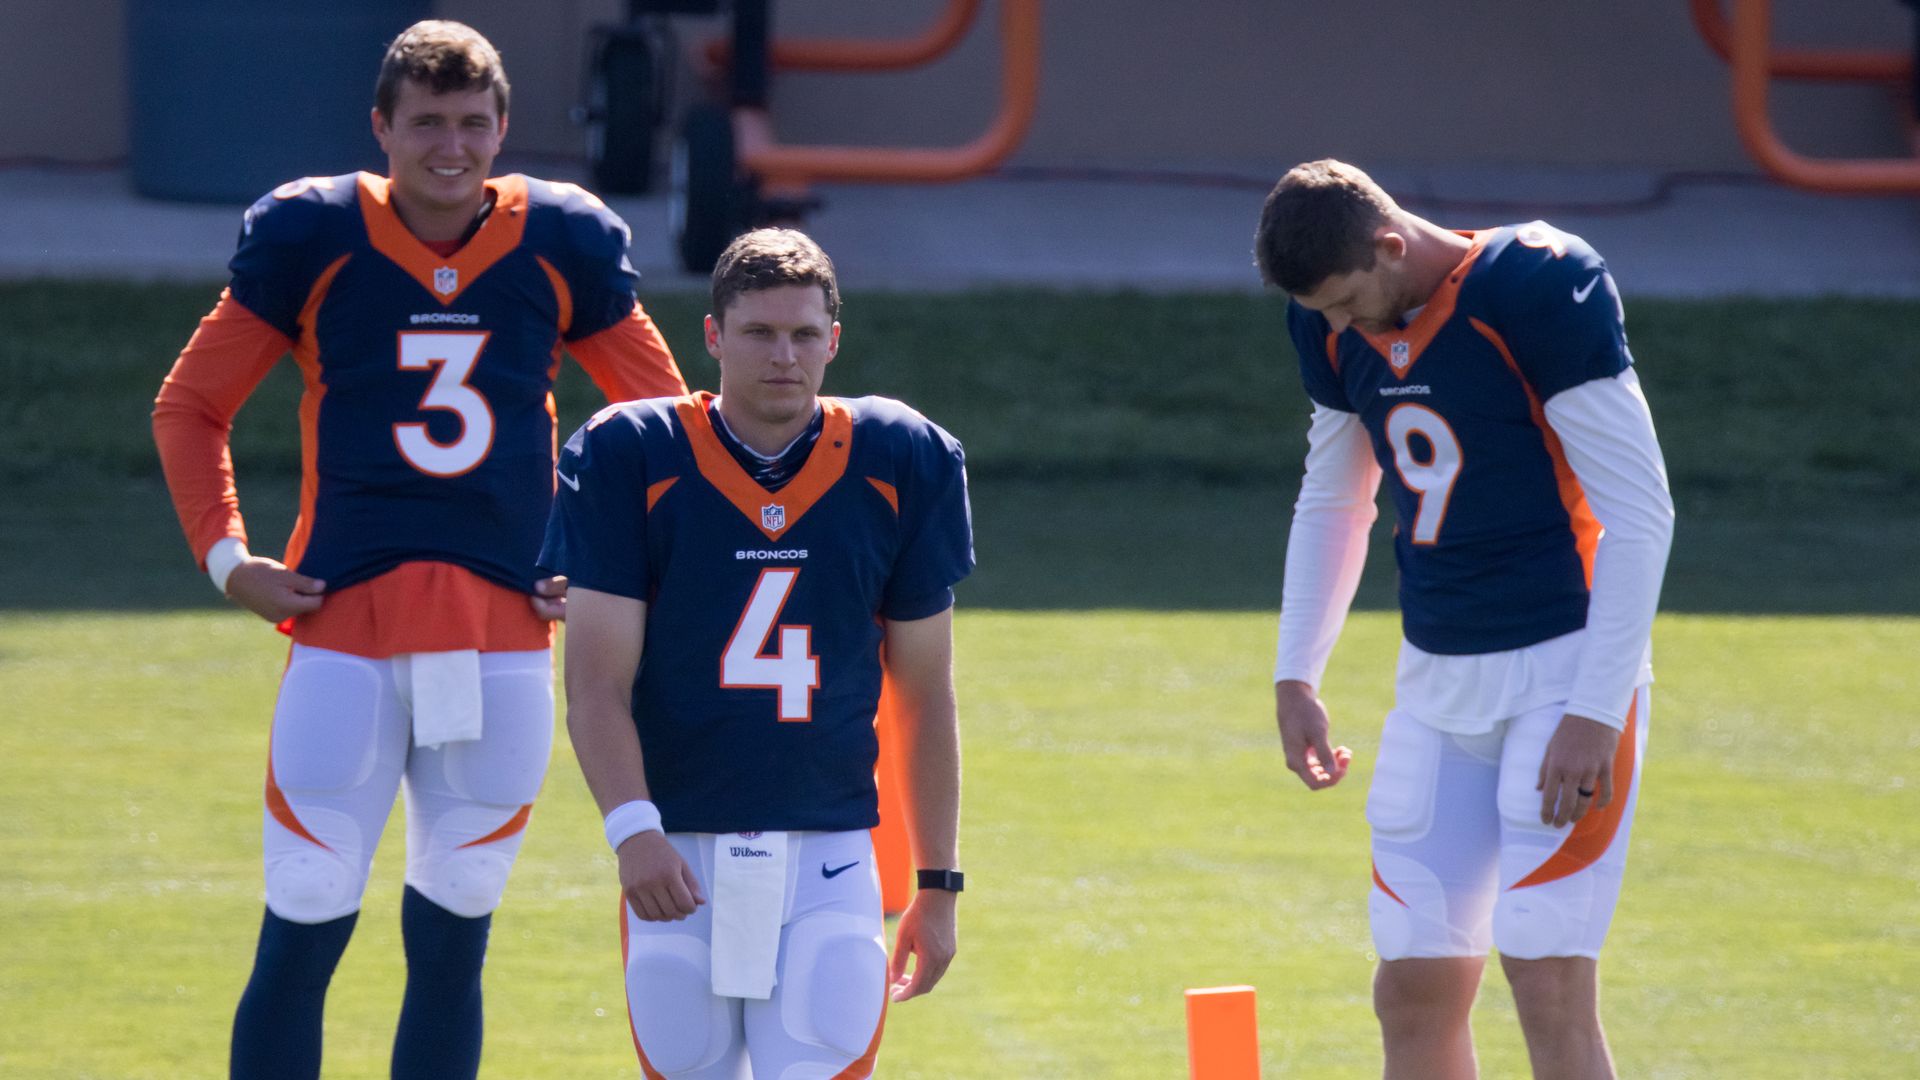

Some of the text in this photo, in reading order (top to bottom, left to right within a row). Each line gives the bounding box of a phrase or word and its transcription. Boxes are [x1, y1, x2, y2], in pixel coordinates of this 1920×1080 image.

[409, 313, 480, 325] BRONCOS
[391, 330, 496, 479] 3
[1384, 402, 1465, 545] 9
[766, 515, 783, 527] NFL
[735, 549, 809, 560] BRONCOS
[719, 567, 821, 722] 4
[729, 846, 768, 857] Wilson
